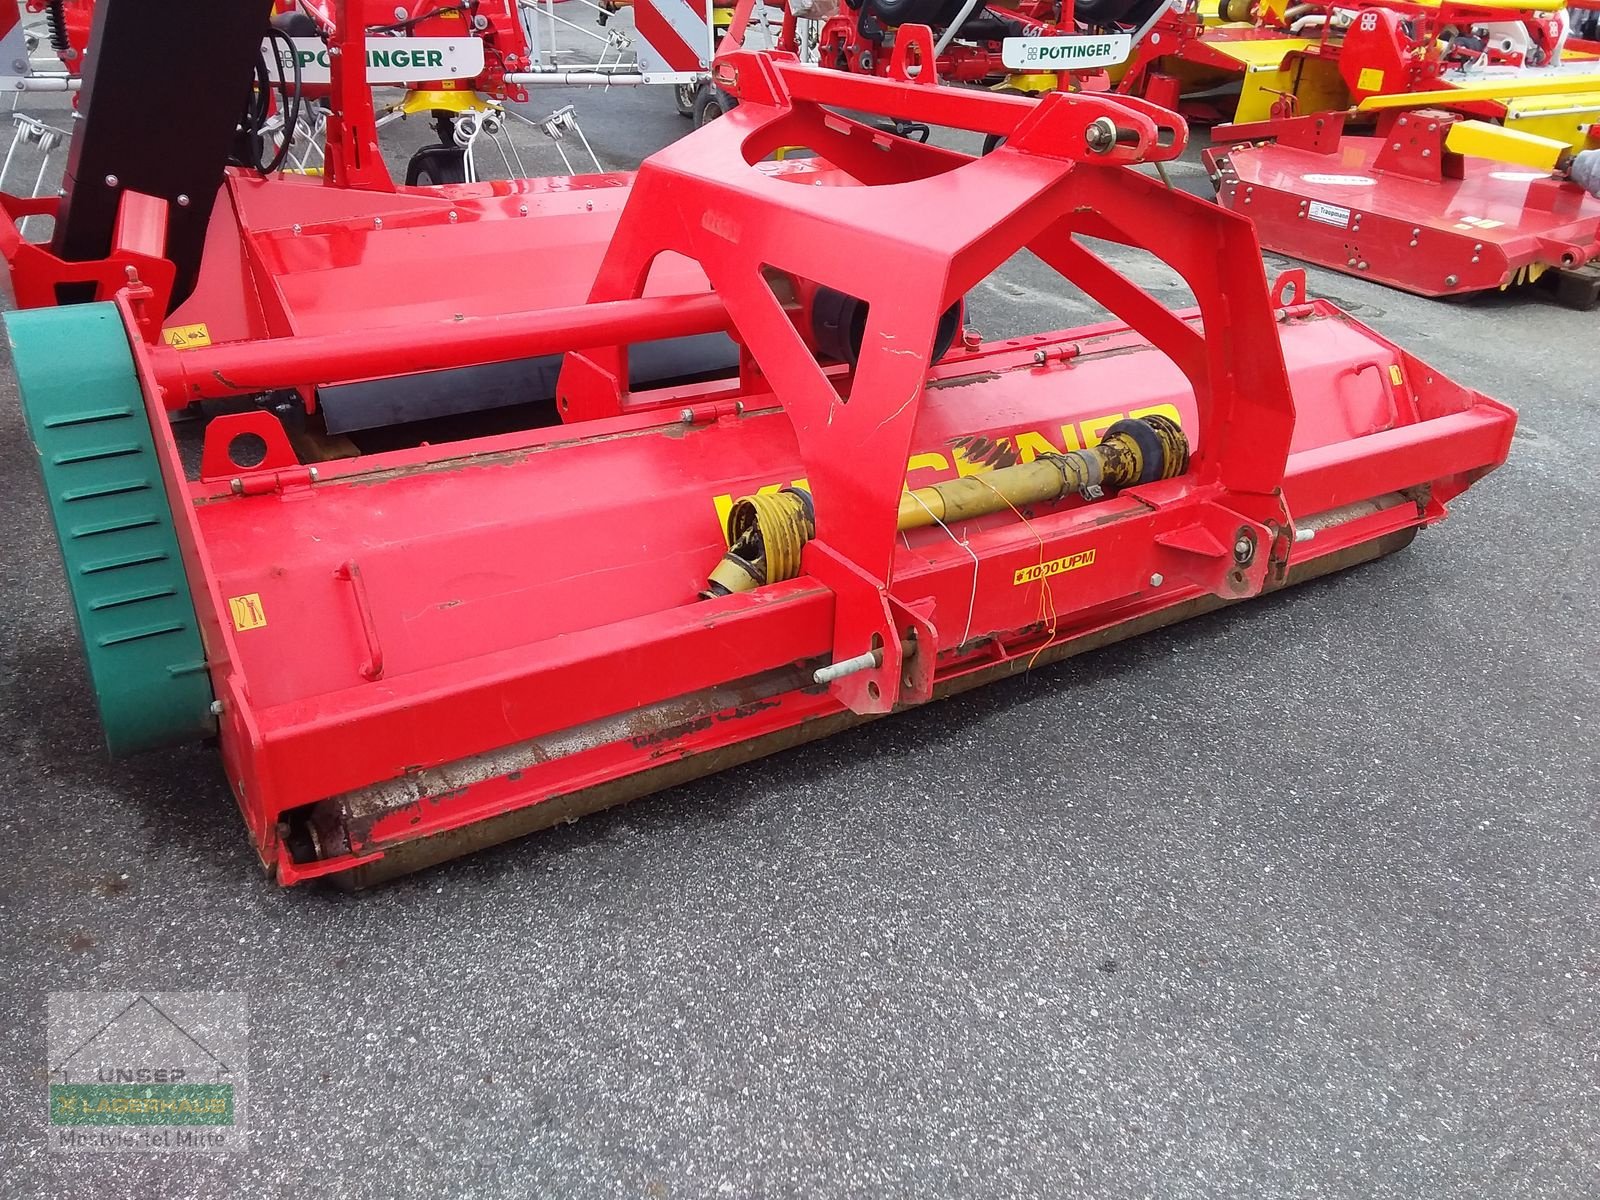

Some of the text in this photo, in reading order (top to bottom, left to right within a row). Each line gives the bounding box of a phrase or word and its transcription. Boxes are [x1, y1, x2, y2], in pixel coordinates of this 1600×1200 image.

[298, 50, 443, 68] PINGER
[1025, 551, 1094, 580] 1000 UPM
